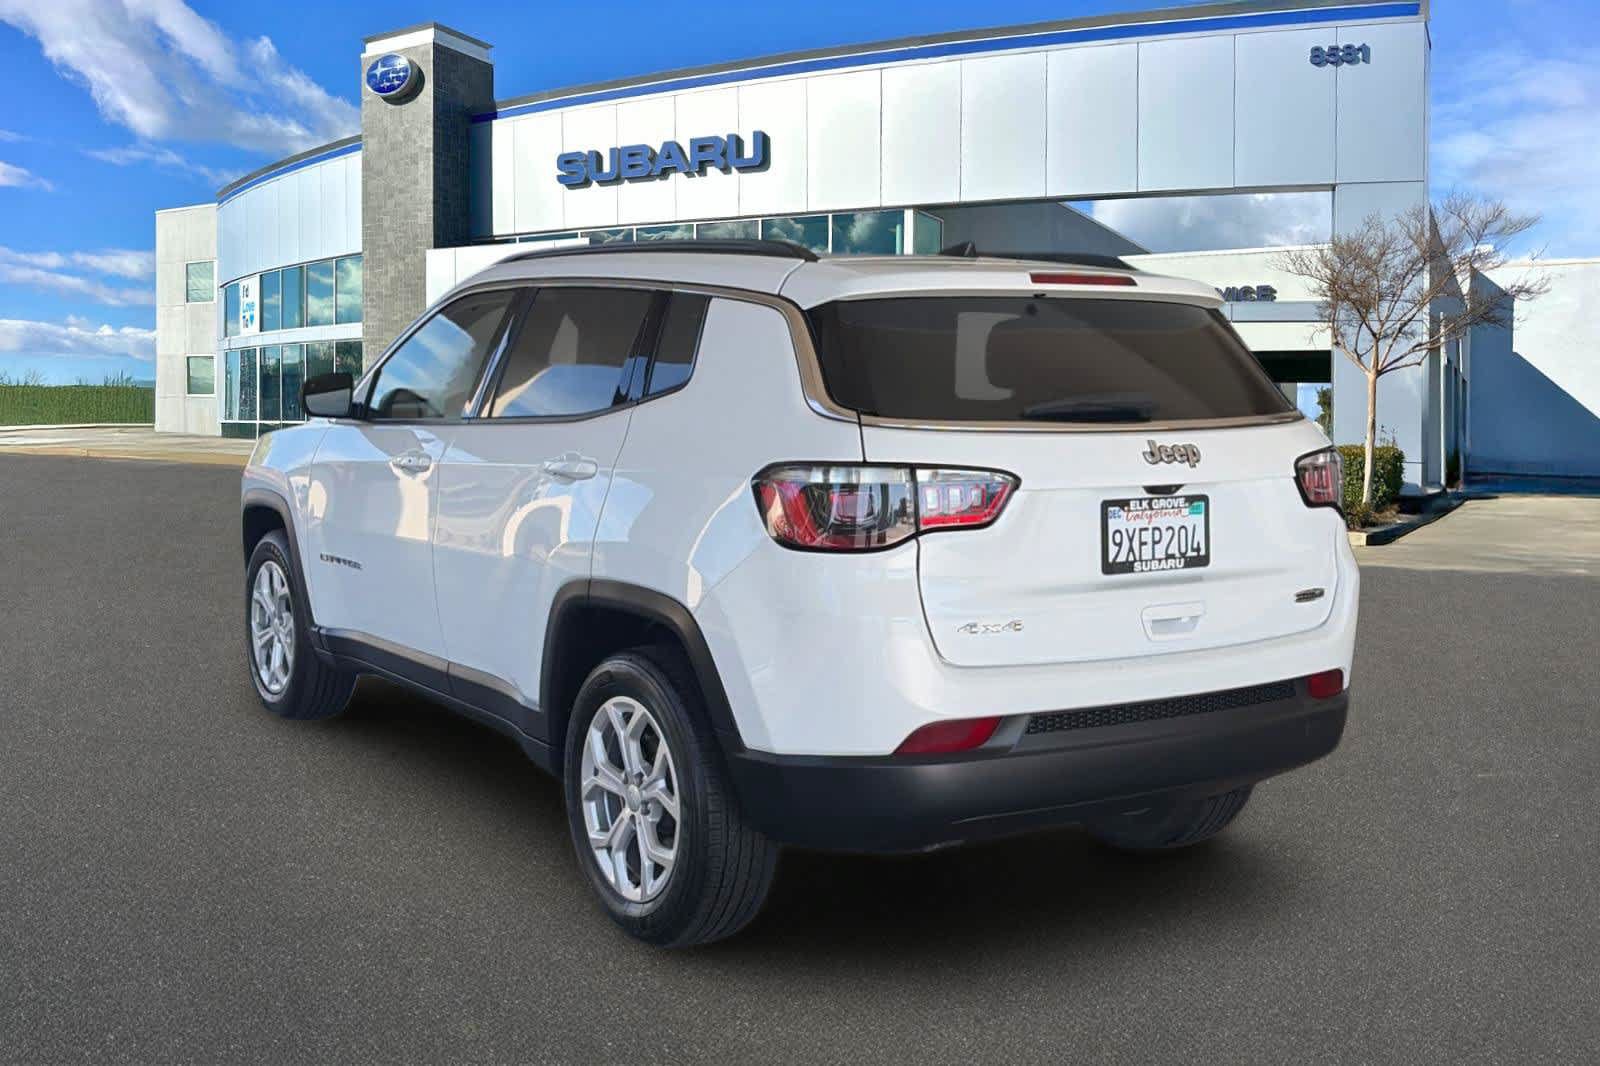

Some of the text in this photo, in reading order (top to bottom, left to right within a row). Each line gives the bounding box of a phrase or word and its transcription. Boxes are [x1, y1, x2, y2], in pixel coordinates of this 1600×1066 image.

[556, 130, 770, 190] SUBARU
[1214, 284, 1277, 302] VICE
[1142, 440, 1201, 468] Jeep
[1129, 498, 1186, 512] ELK GROVE
[1111, 523, 1202, 563] 9XFP204
[1133, 558, 1185, 572] SUBARU
